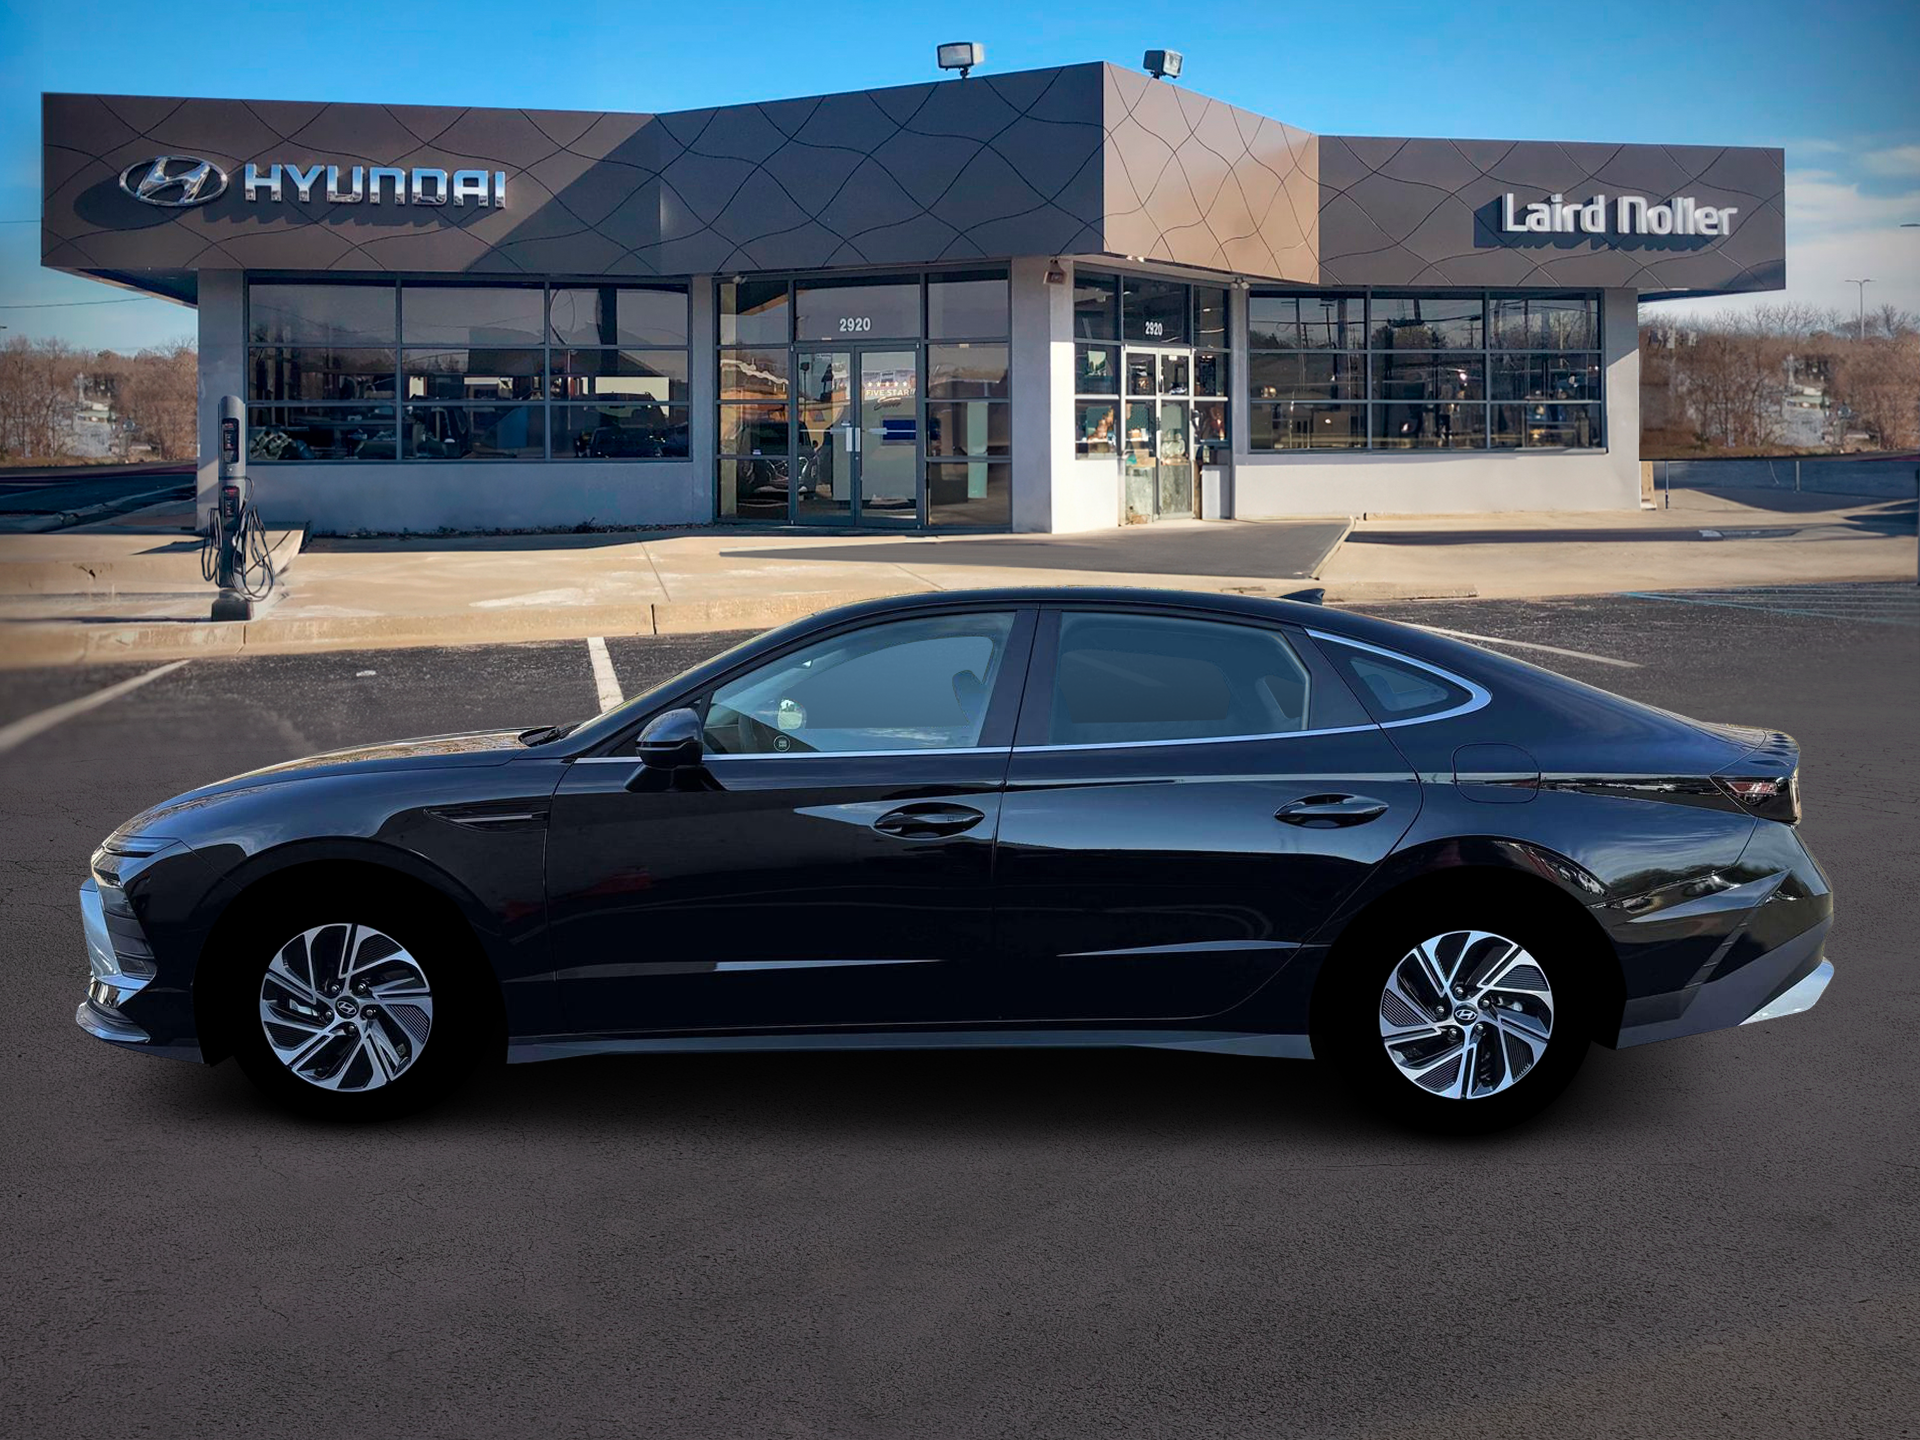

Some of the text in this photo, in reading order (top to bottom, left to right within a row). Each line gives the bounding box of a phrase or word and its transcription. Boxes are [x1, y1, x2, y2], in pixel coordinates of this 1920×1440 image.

[244, 163, 506, 209] HYUNDAI
[1503, 193, 1738, 235] Laird Noller
[839, 317, 871, 332] 2920
[1145, 321, 1163, 336] 2920
[865, 389, 885, 397] FIVE
